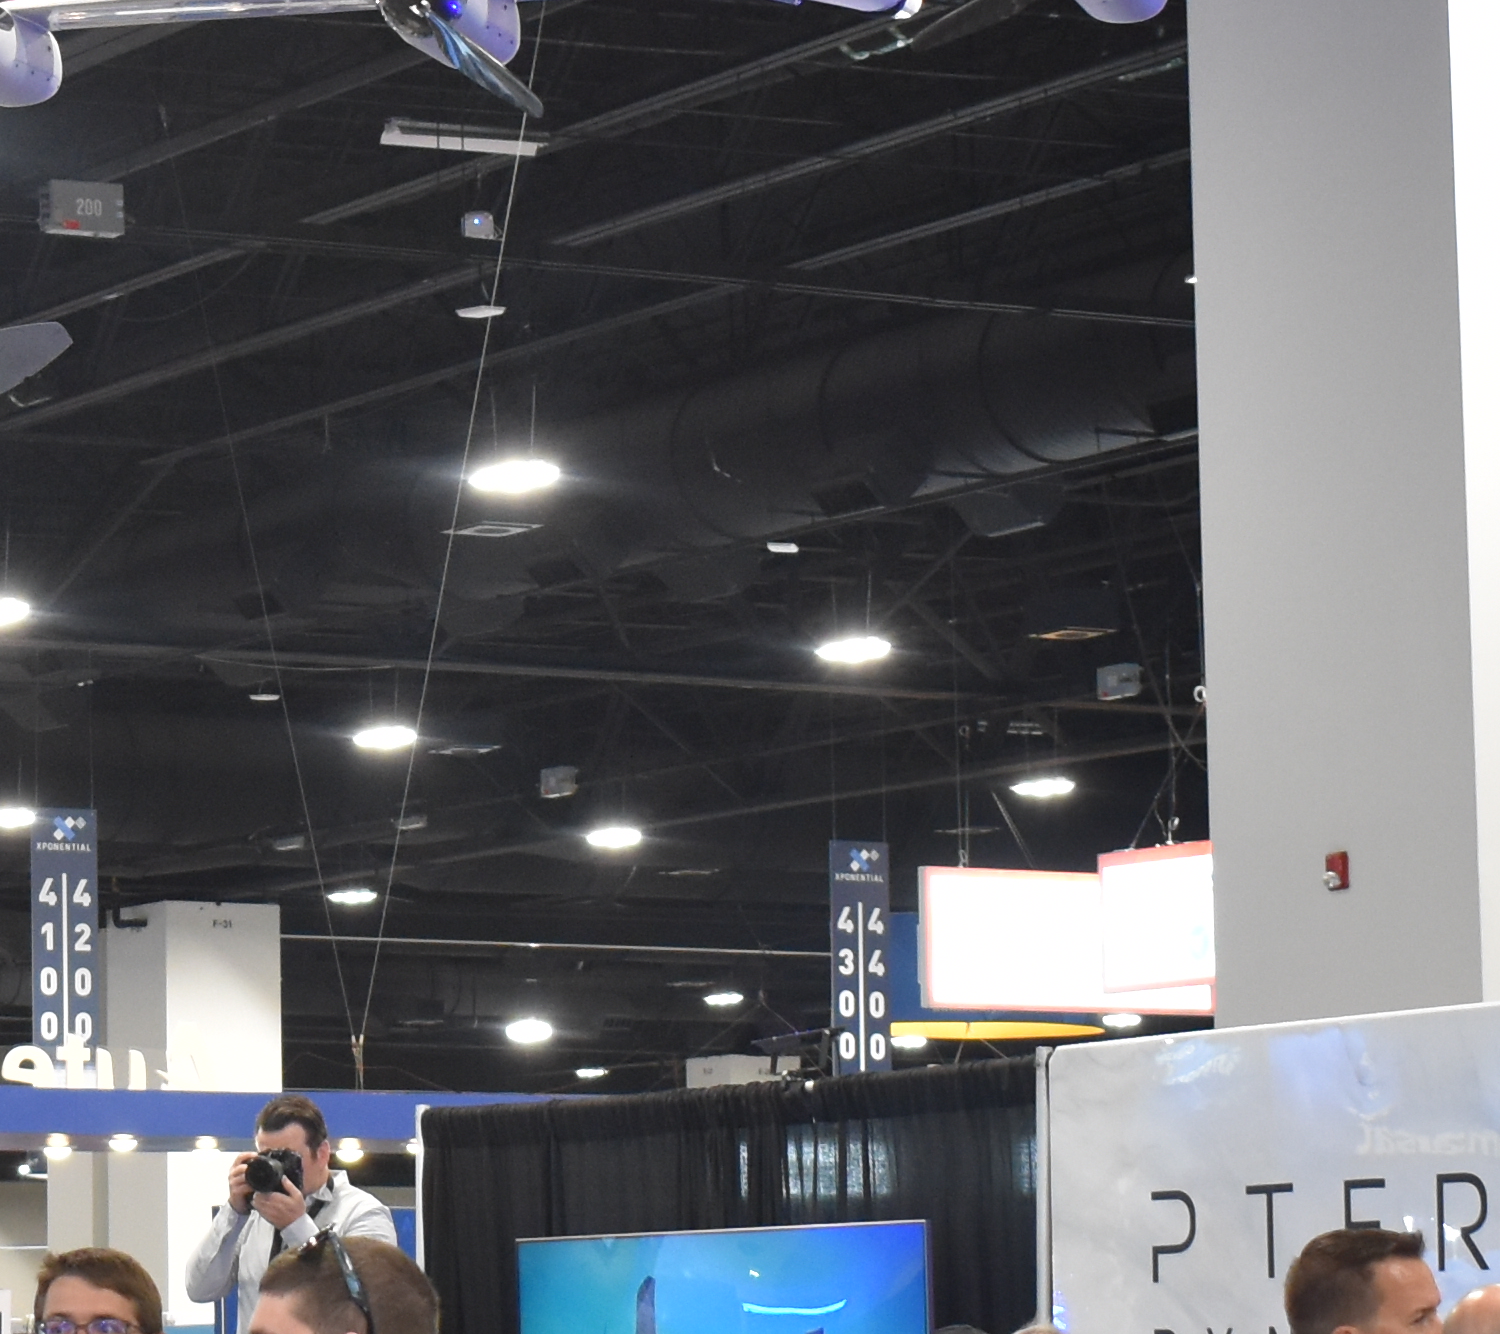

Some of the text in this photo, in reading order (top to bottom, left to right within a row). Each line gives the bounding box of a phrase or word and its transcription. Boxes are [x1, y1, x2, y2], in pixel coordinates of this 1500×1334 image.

[75, 197, 103, 217] 200
[35, 841, 92, 853] XPONENTIAL
[834, 872, 885, 884] XPONENTIAL
[38, 877, 59, 1041] 4100
[72, 878, 93, 1041] 4200
[212, 919, 233, 930] F-31
[836, 905, 857, 1061] 4300
[867, 906, 887, 1062] 4400
